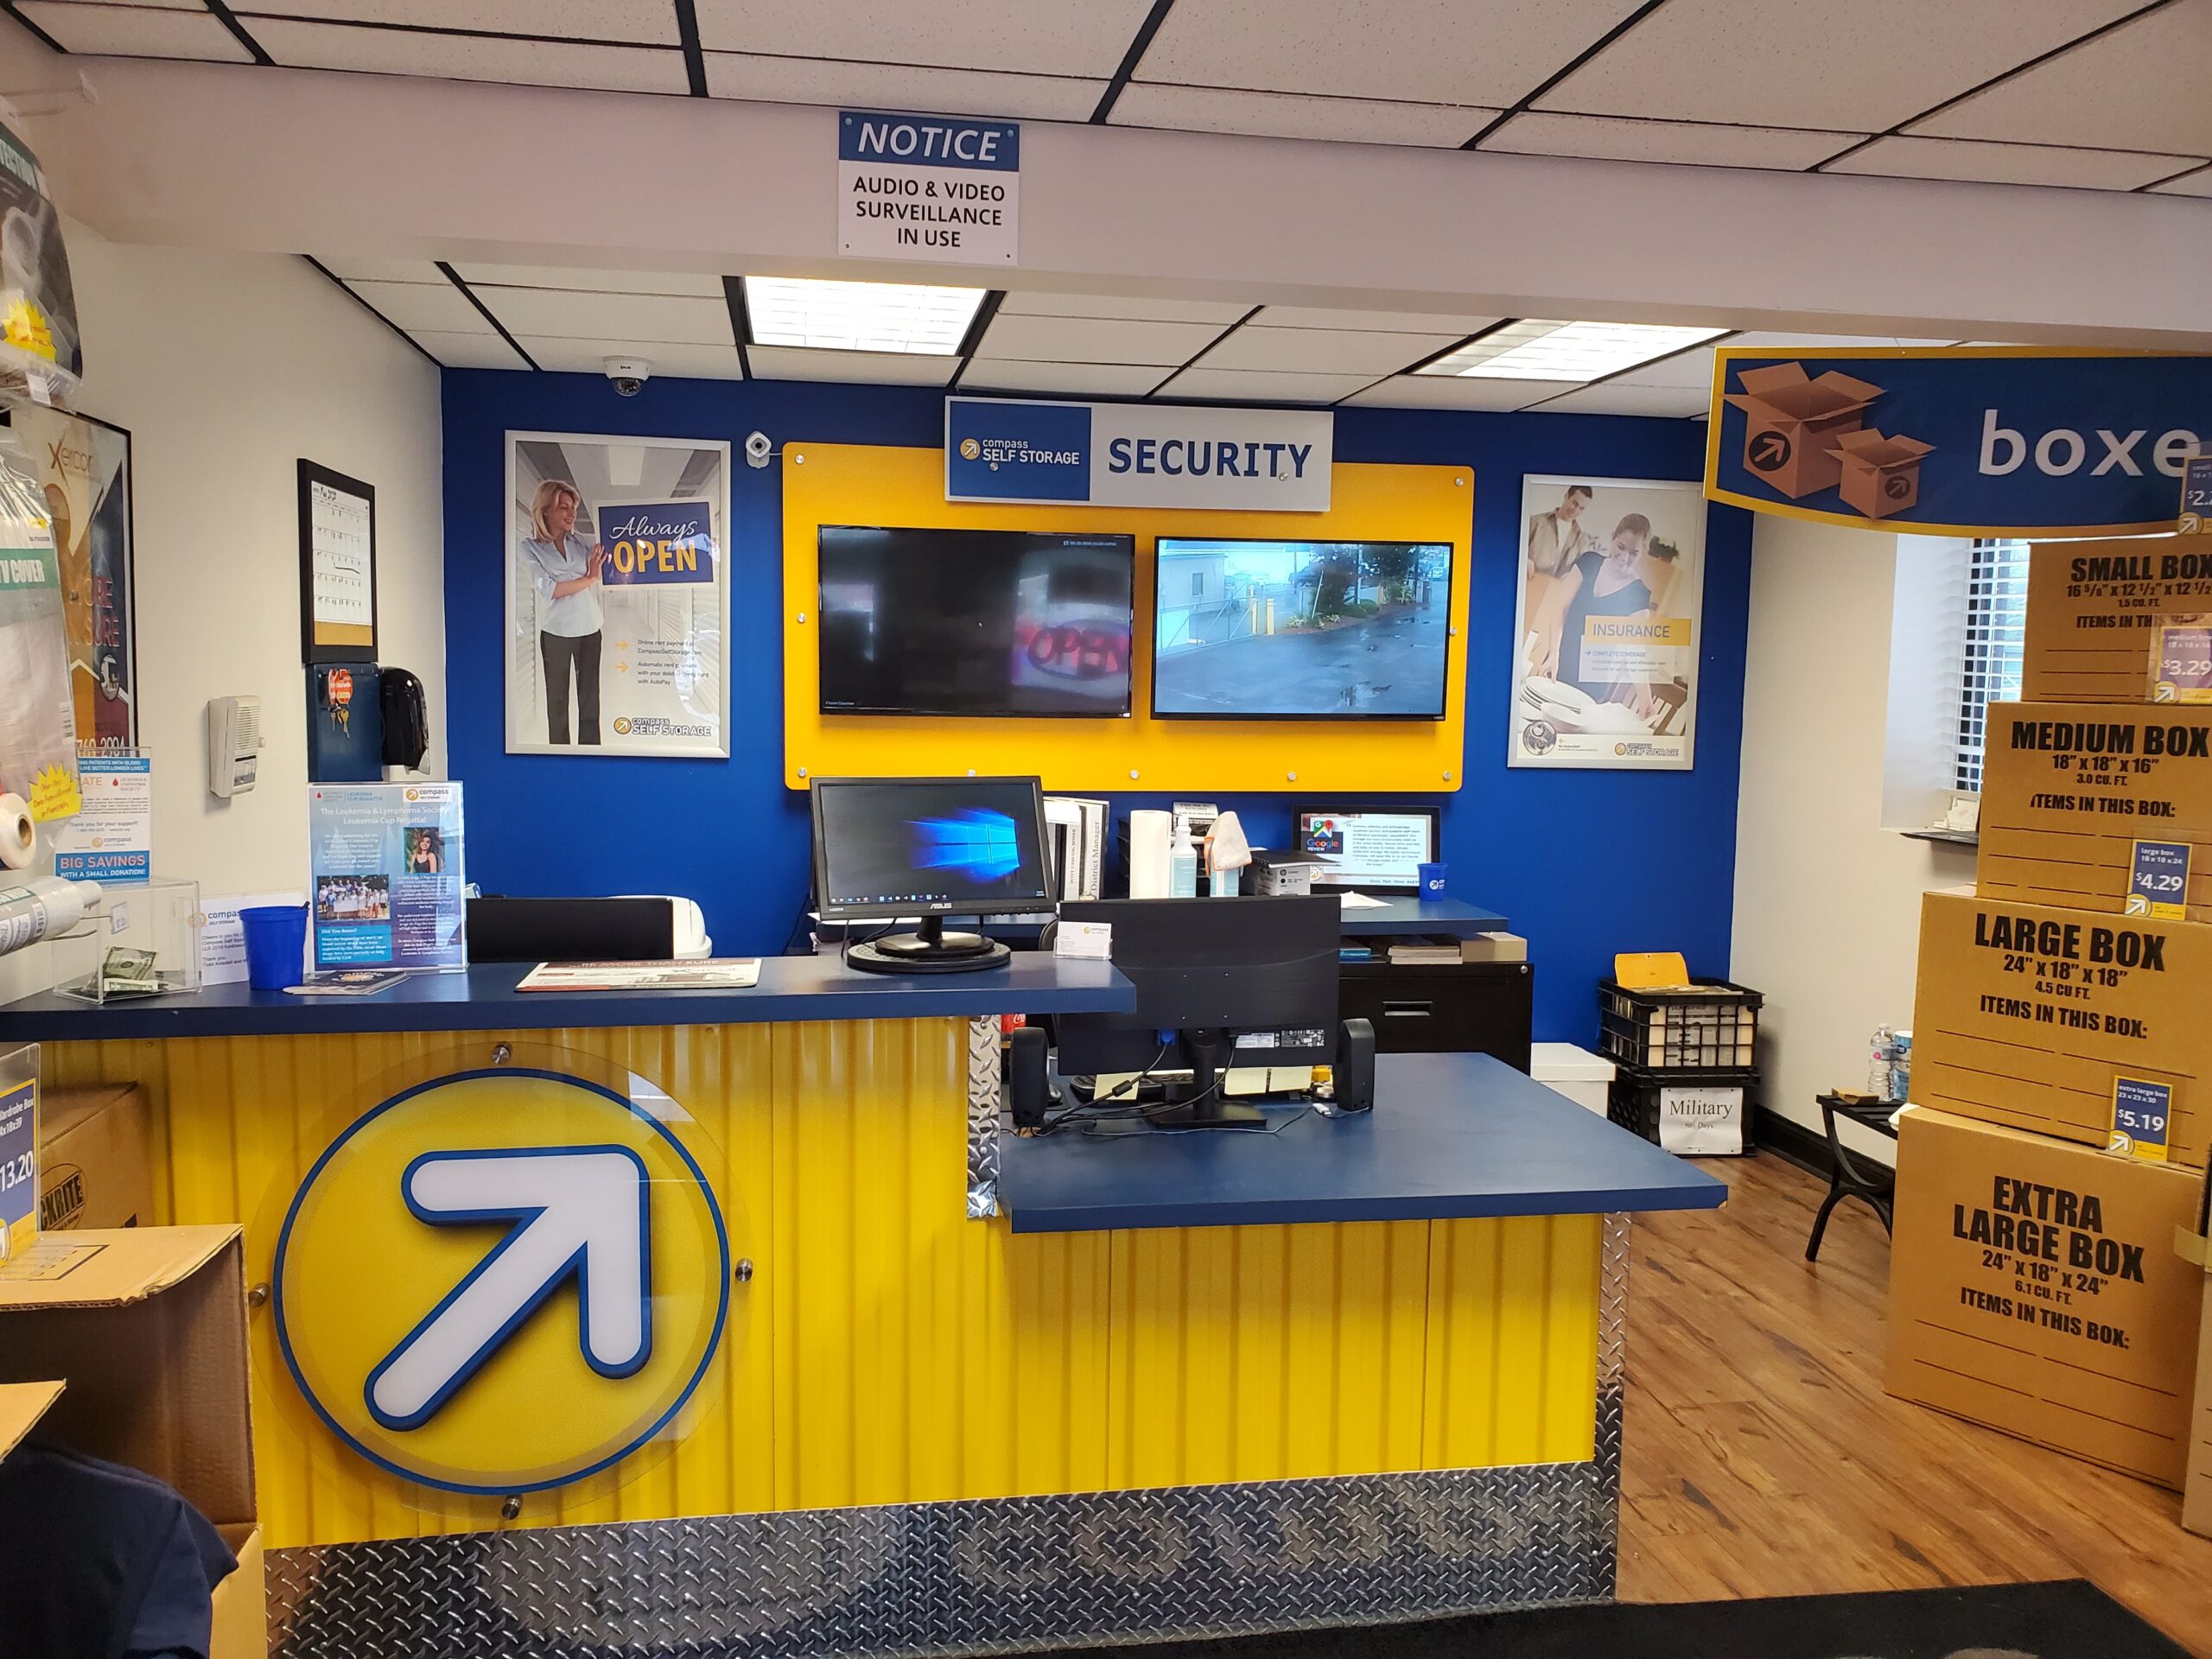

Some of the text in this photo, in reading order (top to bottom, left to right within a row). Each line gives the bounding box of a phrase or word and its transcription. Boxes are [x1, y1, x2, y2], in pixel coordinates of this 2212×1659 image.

[858, 123, 1001, 162] NOTICE
[853, 176, 1005, 201] AUDIO & VIDEO
[856, 201, 1002, 226] SURVEILLANCE
[898, 228, 961, 247] IN USE
[982, 437, 1029, 450] compass
[982, 448, 1079, 465] SELF STORAGE
[1109, 439, 1312, 478] SECURITY
[609, 516, 698, 547] Always
[613, 539, 697, 574] OPEN
[2071, 554, 2212, 582] SMALL BOX
[11, 560, 45, 583] COVER
[2067, 582, 2190, 597] 16 12 12
[1592, 623, 1670, 638] INSURANCE
[2076, 615, 2116, 628] ITEMS
[2119, 615, 2133, 628] IN
[2164, 659, 2212, 677] $3.29
[632, 717, 670, 726] compass
[632, 725, 712, 736] SELF STORAGE
[2012, 721, 2210, 758] MEDIUM BOX
[2076, 774, 2127, 785] 3.0 CU. FT.
[2031, 793, 2176, 817] ITEMS IN THIS BOX:
[1306, 838, 1339, 849] Google
[2141, 848, 2159, 856] large
[60, 855, 145, 869] BIG SAVINGS
[2136, 873, 2183, 892] $4.29
[1975, 912, 2166, 972] LARGE BOX
[2035, 981, 2090, 1000] 4.5 CU FT.
[1980, 995, 2148, 1039] ITEMS IN THIS BOX:
[2137, 1087, 2155, 1096] large
[2156, 1089, 2168, 1097] box
[1669, 1100, 1733, 1119] Military
[2118, 1109, 2164, 1132] $5.19
[0, 1150, 34, 1192] 13.20
[1993, 1175, 2103, 1233] EXTRA
[1954, 1204, 2145, 1284] LARGE BOX
[2015, 1280, 2072, 1306] 6.1 CU. FT.
[1961, 1287, 2130, 1349] ITEMS IN THIS BOX:
